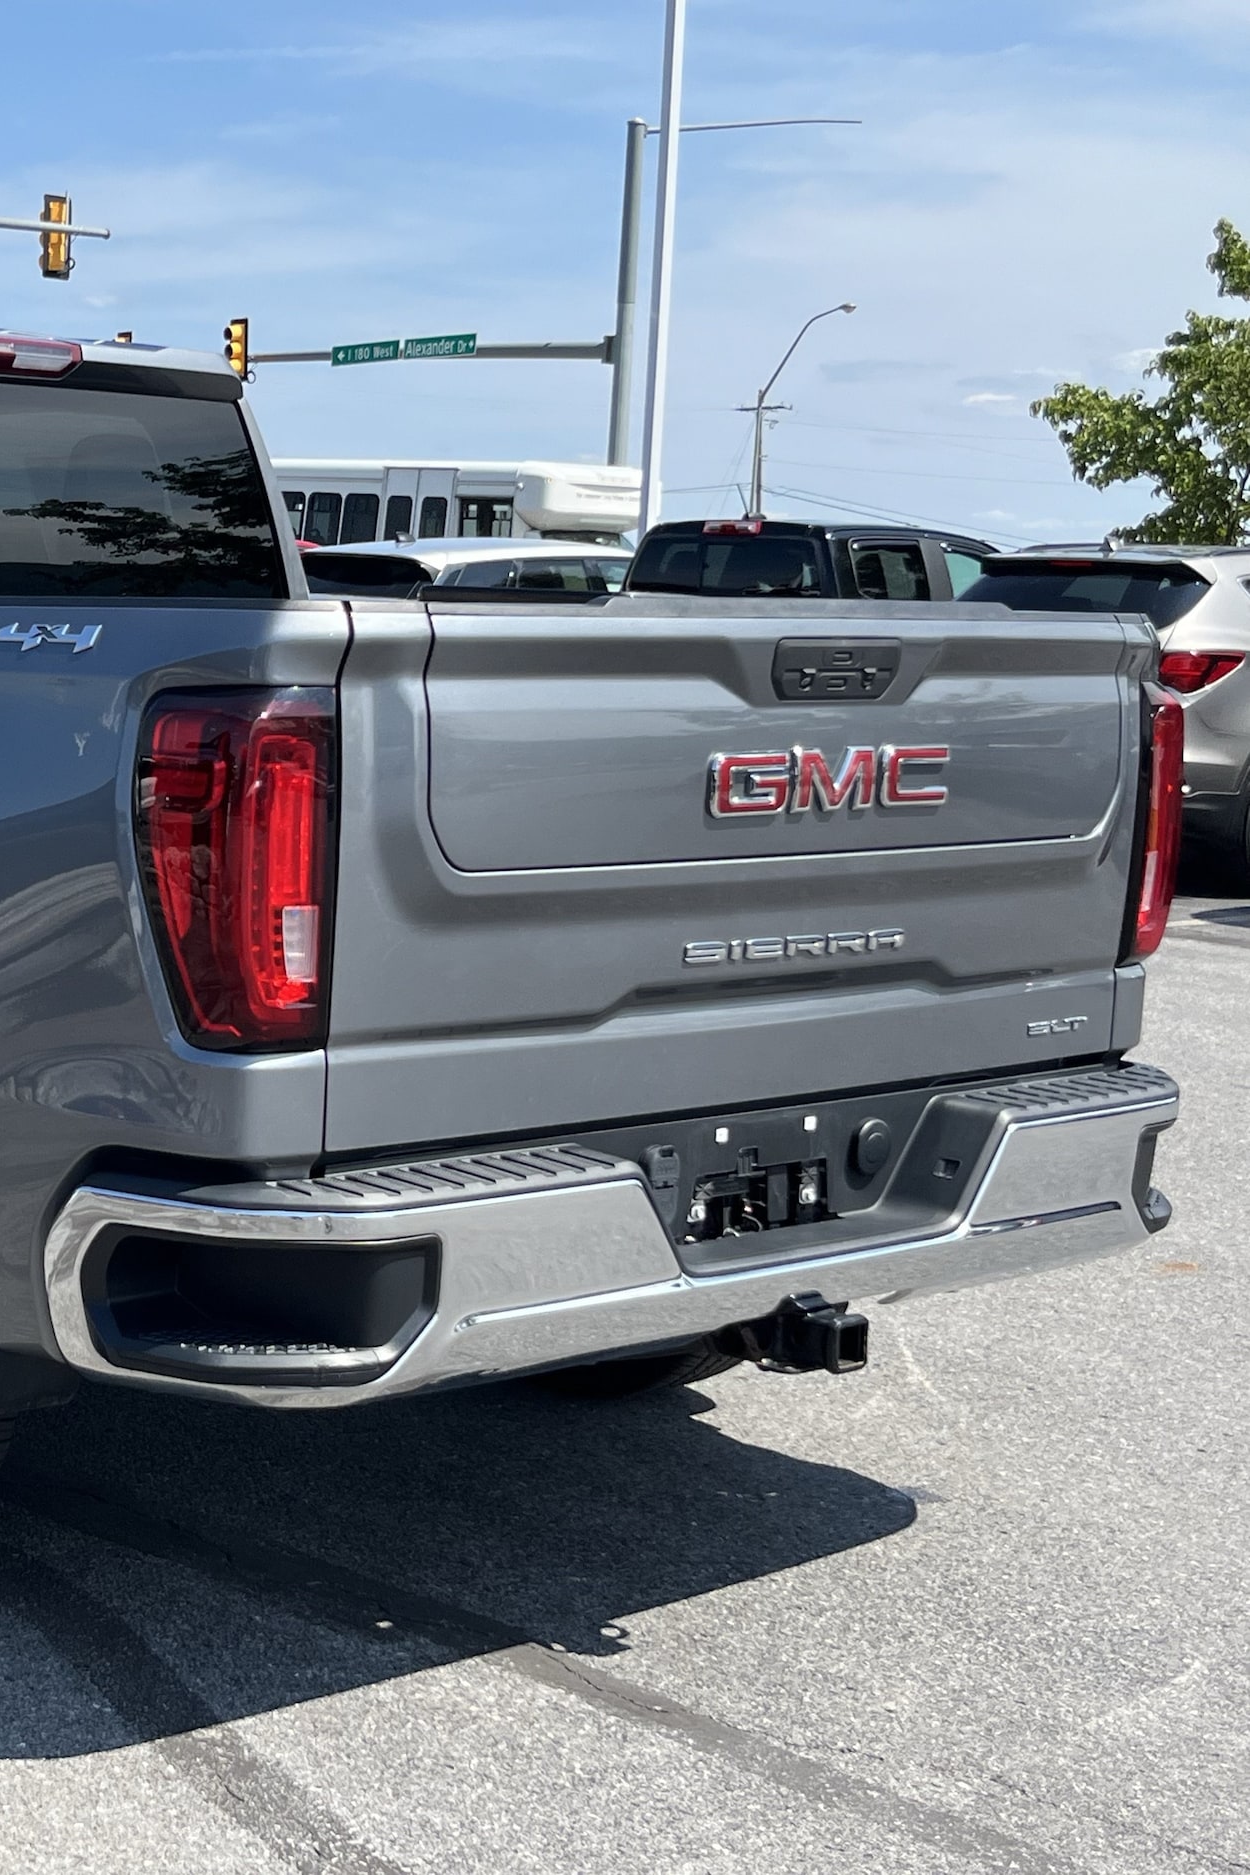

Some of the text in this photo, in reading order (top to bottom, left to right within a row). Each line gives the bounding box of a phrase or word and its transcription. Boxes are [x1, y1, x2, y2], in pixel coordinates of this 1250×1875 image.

[354, 348, 370, 361] 180
[373, 345, 393, 359] West
[405, 339, 468, 357] Alexander Dr
[708, 744, 951, 819] GMC
[682, 928, 905, 965] SIERRA
[1026, 1015, 1088, 1037] SLT
